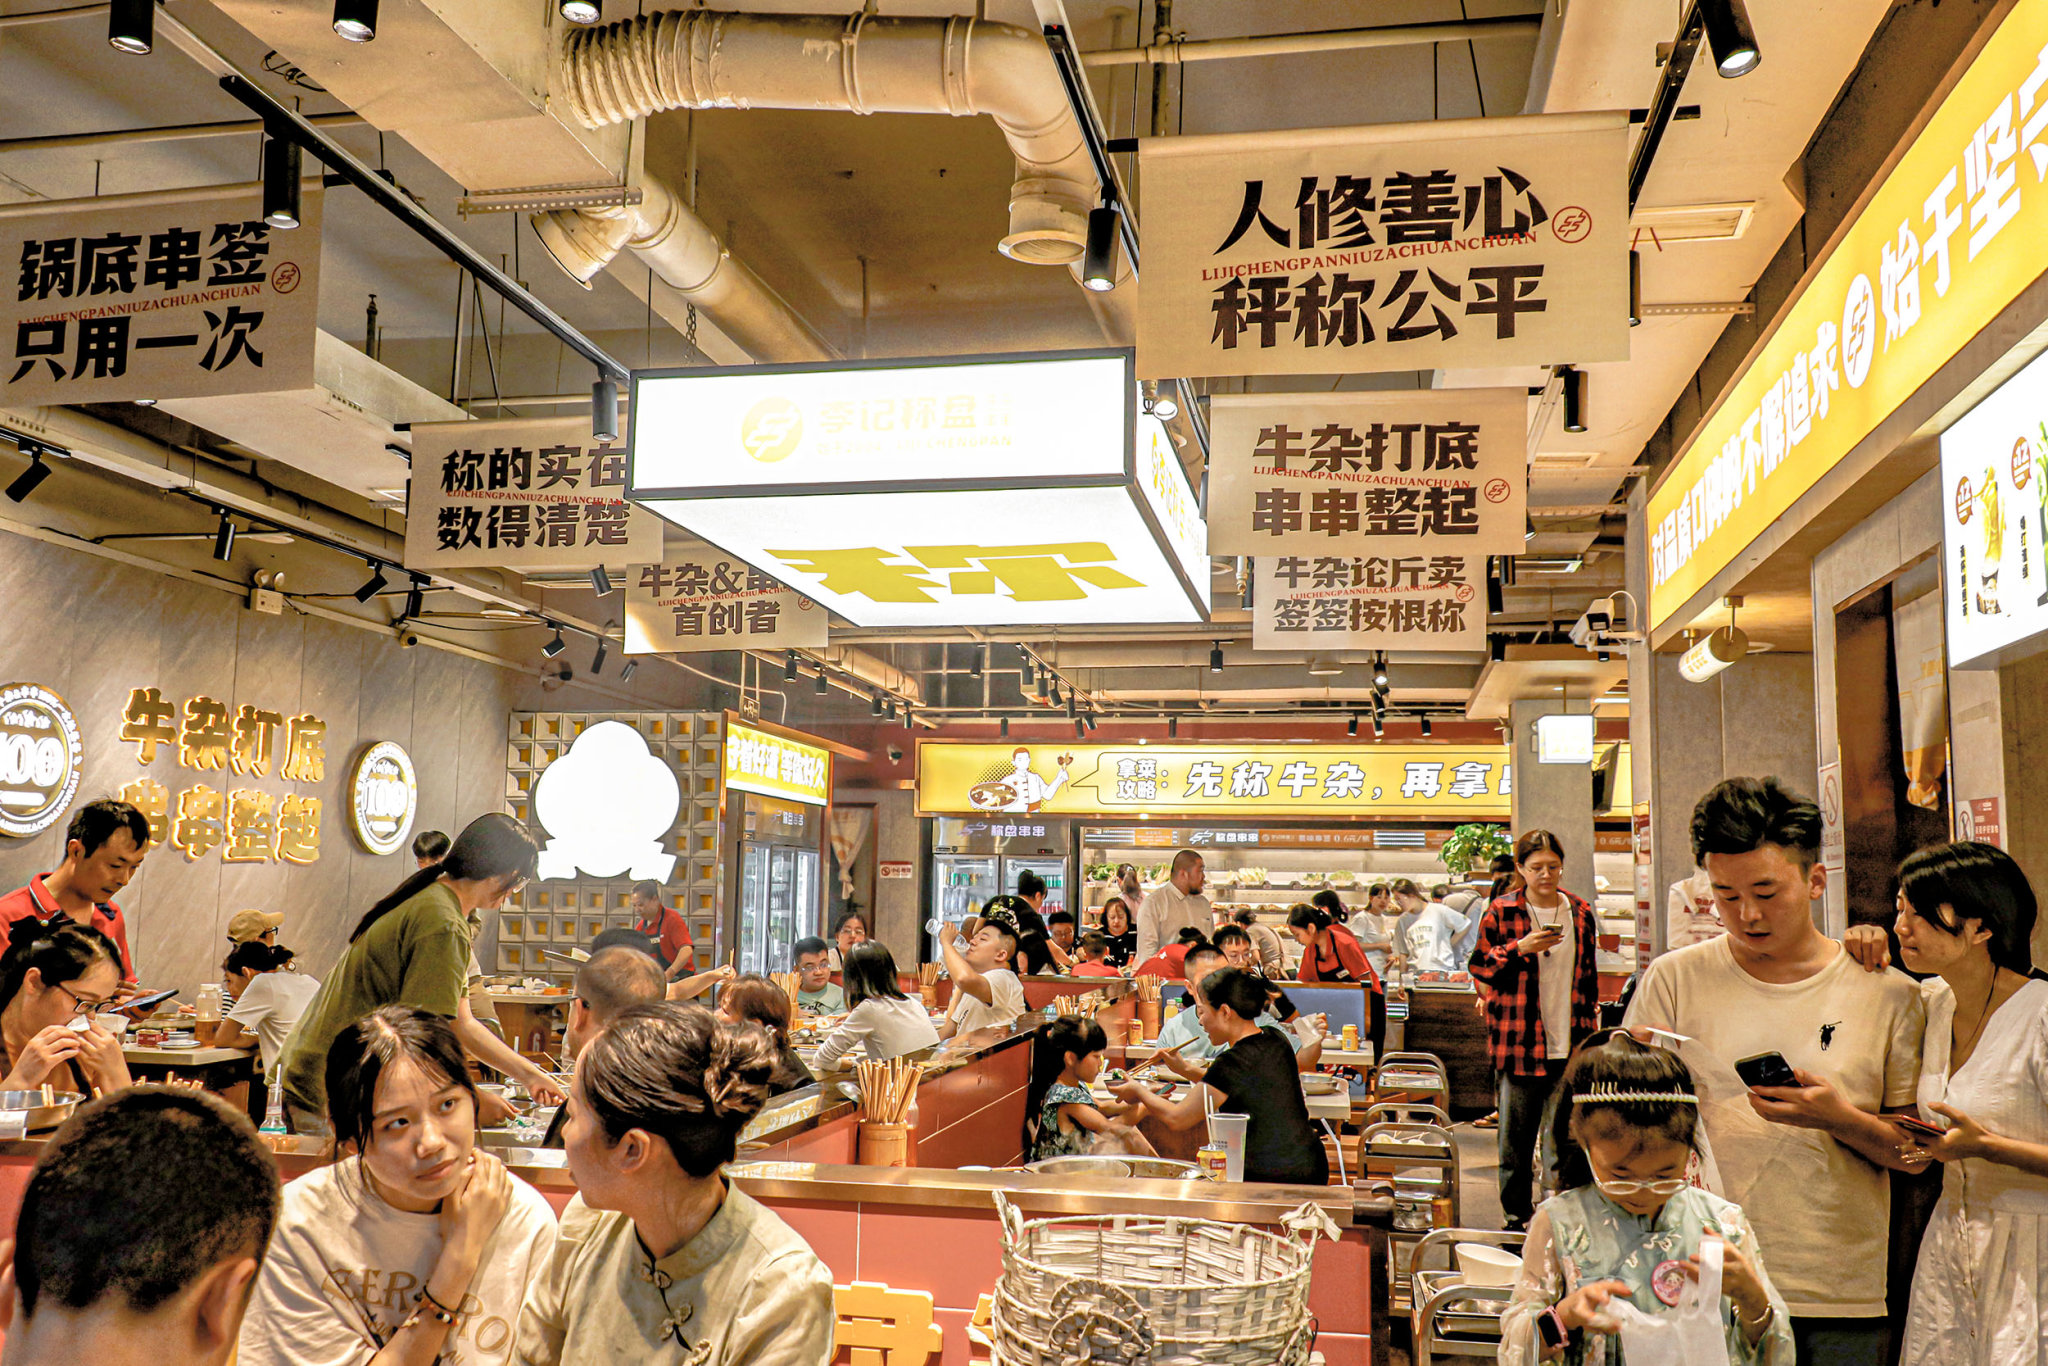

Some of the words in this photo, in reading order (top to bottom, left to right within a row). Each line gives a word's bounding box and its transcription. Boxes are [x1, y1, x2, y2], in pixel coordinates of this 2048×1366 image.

[1213, 166, 1549, 255] 人修善心
[17, 221, 271, 301] 锅底串签
[1201, 230, 1538, 281] LIJICHENGPANNIUZACHUANCHUAN
[1211, 263, 1548, 350] 秤称公平
[7, 305, 265, 385] 只用一次
[440, 443, 626, 492] 称的实在
[1252, 421, 1480, 473] 牛杂打底
[1253, 466, 1471, 490] LIJICHENGPANNIUZACHUANCHUAN
[436, 502, 631, 551] 数得清楚
[1252, 487, 1479, 537] 串串整起
[1273, 556, 1467, 589] 牛杂论斤卖
[672, 600, 781, 637] 首创者
[1273, 598, 1467, 633] 签签按根称
[119, 687, 328, 783] 牛杂打底
[1116, 757, 1157, 779] 拿菜
[1116, 779, 1157, 800] 攻略
[119, 776, 324, 864] 串串整起
